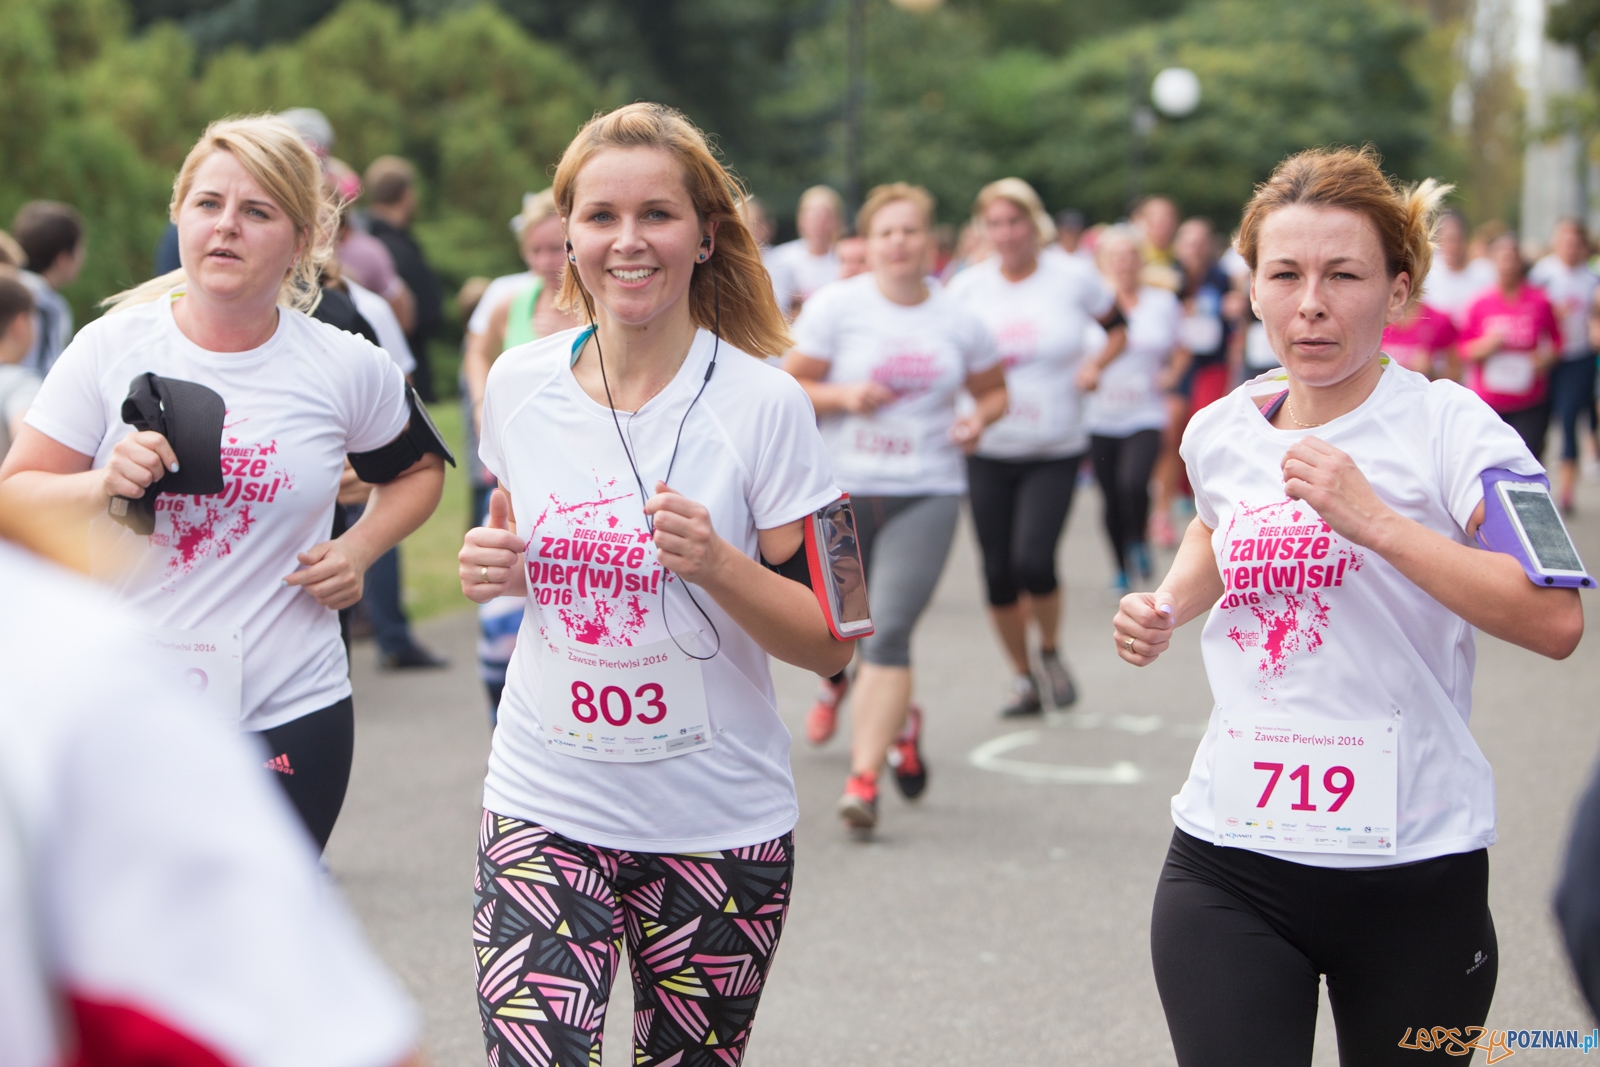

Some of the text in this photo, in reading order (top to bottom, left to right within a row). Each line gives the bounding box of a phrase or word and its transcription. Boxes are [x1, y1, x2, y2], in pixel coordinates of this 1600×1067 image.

[154, 499, 185, 512] 016
[573, 528, 635, 545] BIEG KOBIET
[1258, 525, 1318, 537] BIEG KOBIET
[538, 536, 645, 569] zawsze
[1229, 536, 1330, 562] zawsze
[528, 561, 661, 599] pier(w)si!
[192, 643, 217, 653] 2016
[568, 652, 669, 670] Zawsze Pier(w)si 2016
[570, 680, 668, 728] 803
[1254, 731, 1290, 744] Zawsze
[1292, 733, 1335, 747] Pier(w)si
[1337, 736, 1365, 747] 2016
[263, 761, 295, 776] adidas
[1253, 761, 1355, 813] 719
